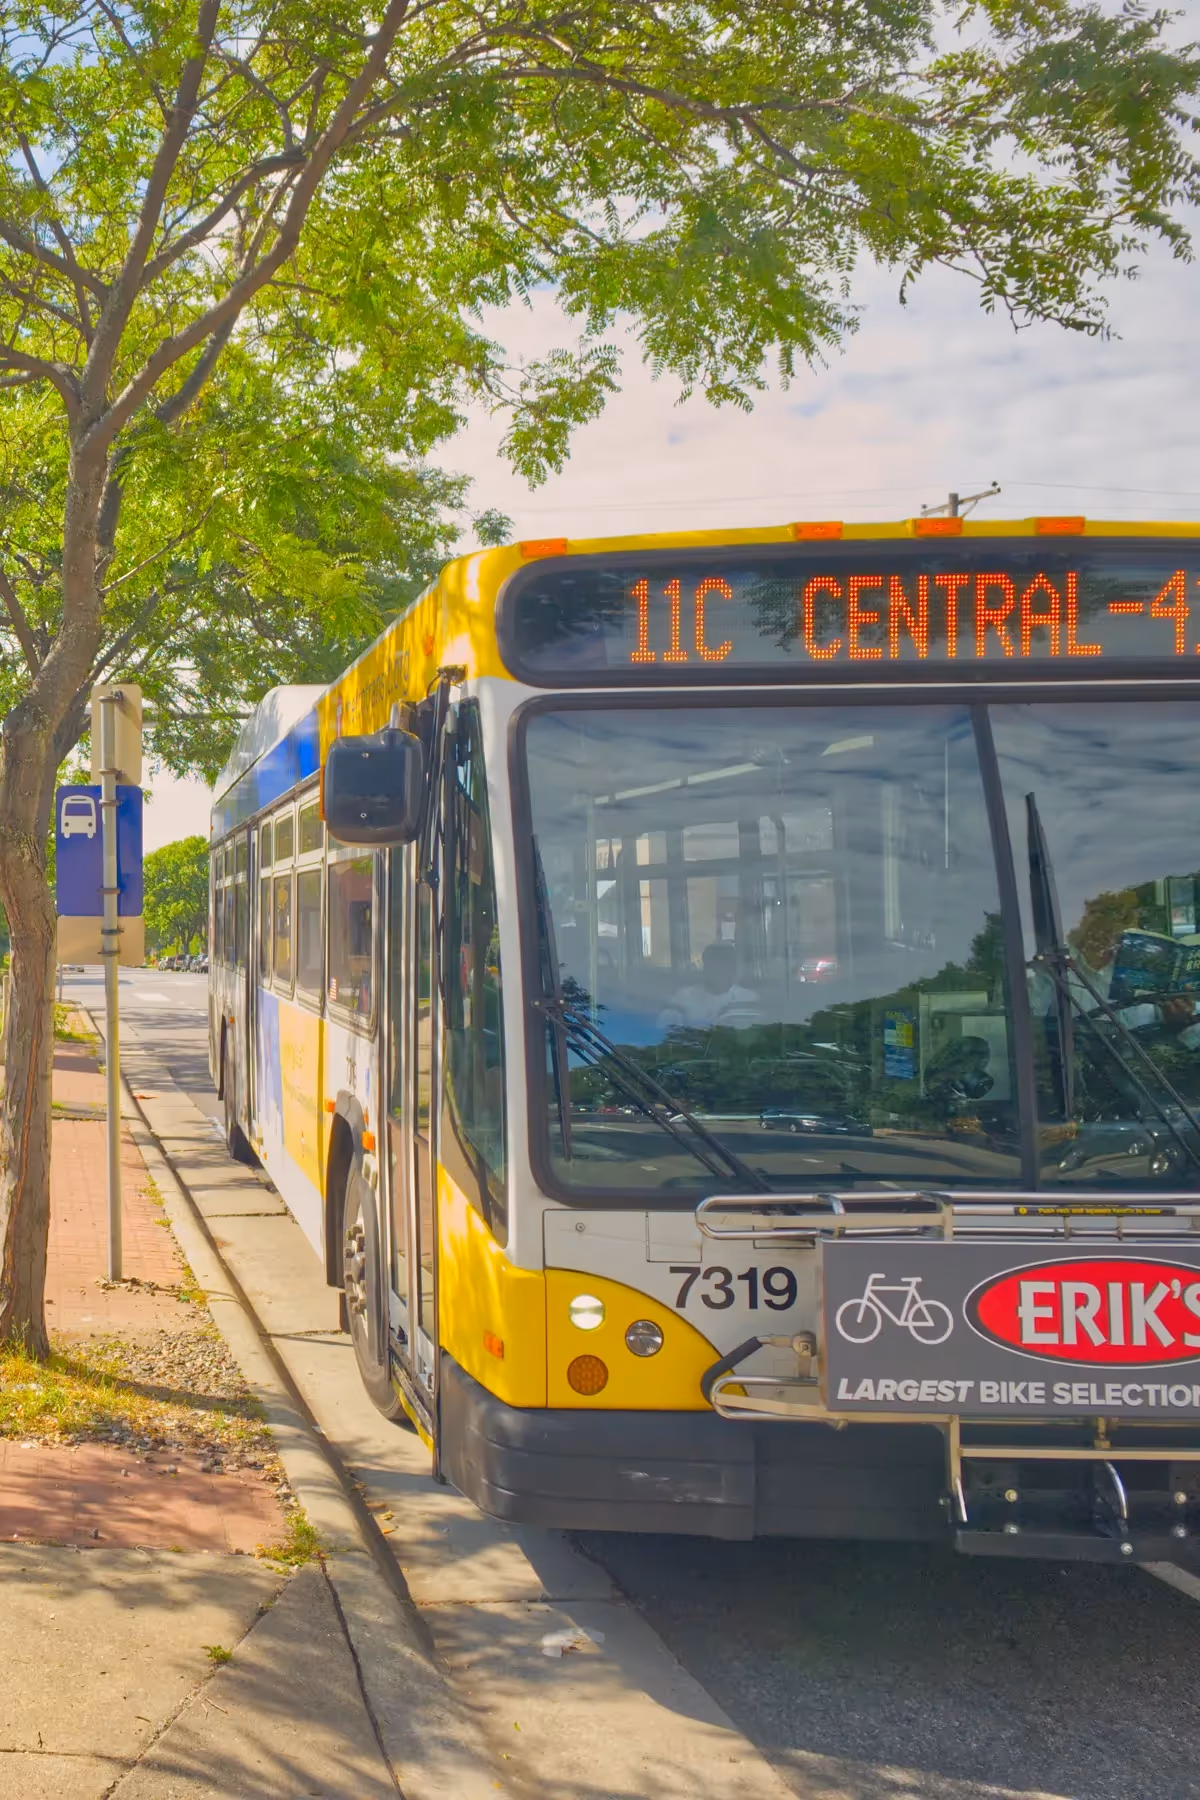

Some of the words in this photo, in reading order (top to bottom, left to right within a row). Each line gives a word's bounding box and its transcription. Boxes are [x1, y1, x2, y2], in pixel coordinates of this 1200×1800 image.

[631, 577, 733, 664] 11C
[803, 569, 1200, 661] CENTRAL-4
[669, 1266, 798, 1311] 7319
[837, 1377, 974, 1404] LARGEST
[980, 1380, 1046, 1405] BIKE
[1052, 1382, 1200, 1408] SELECTIO
